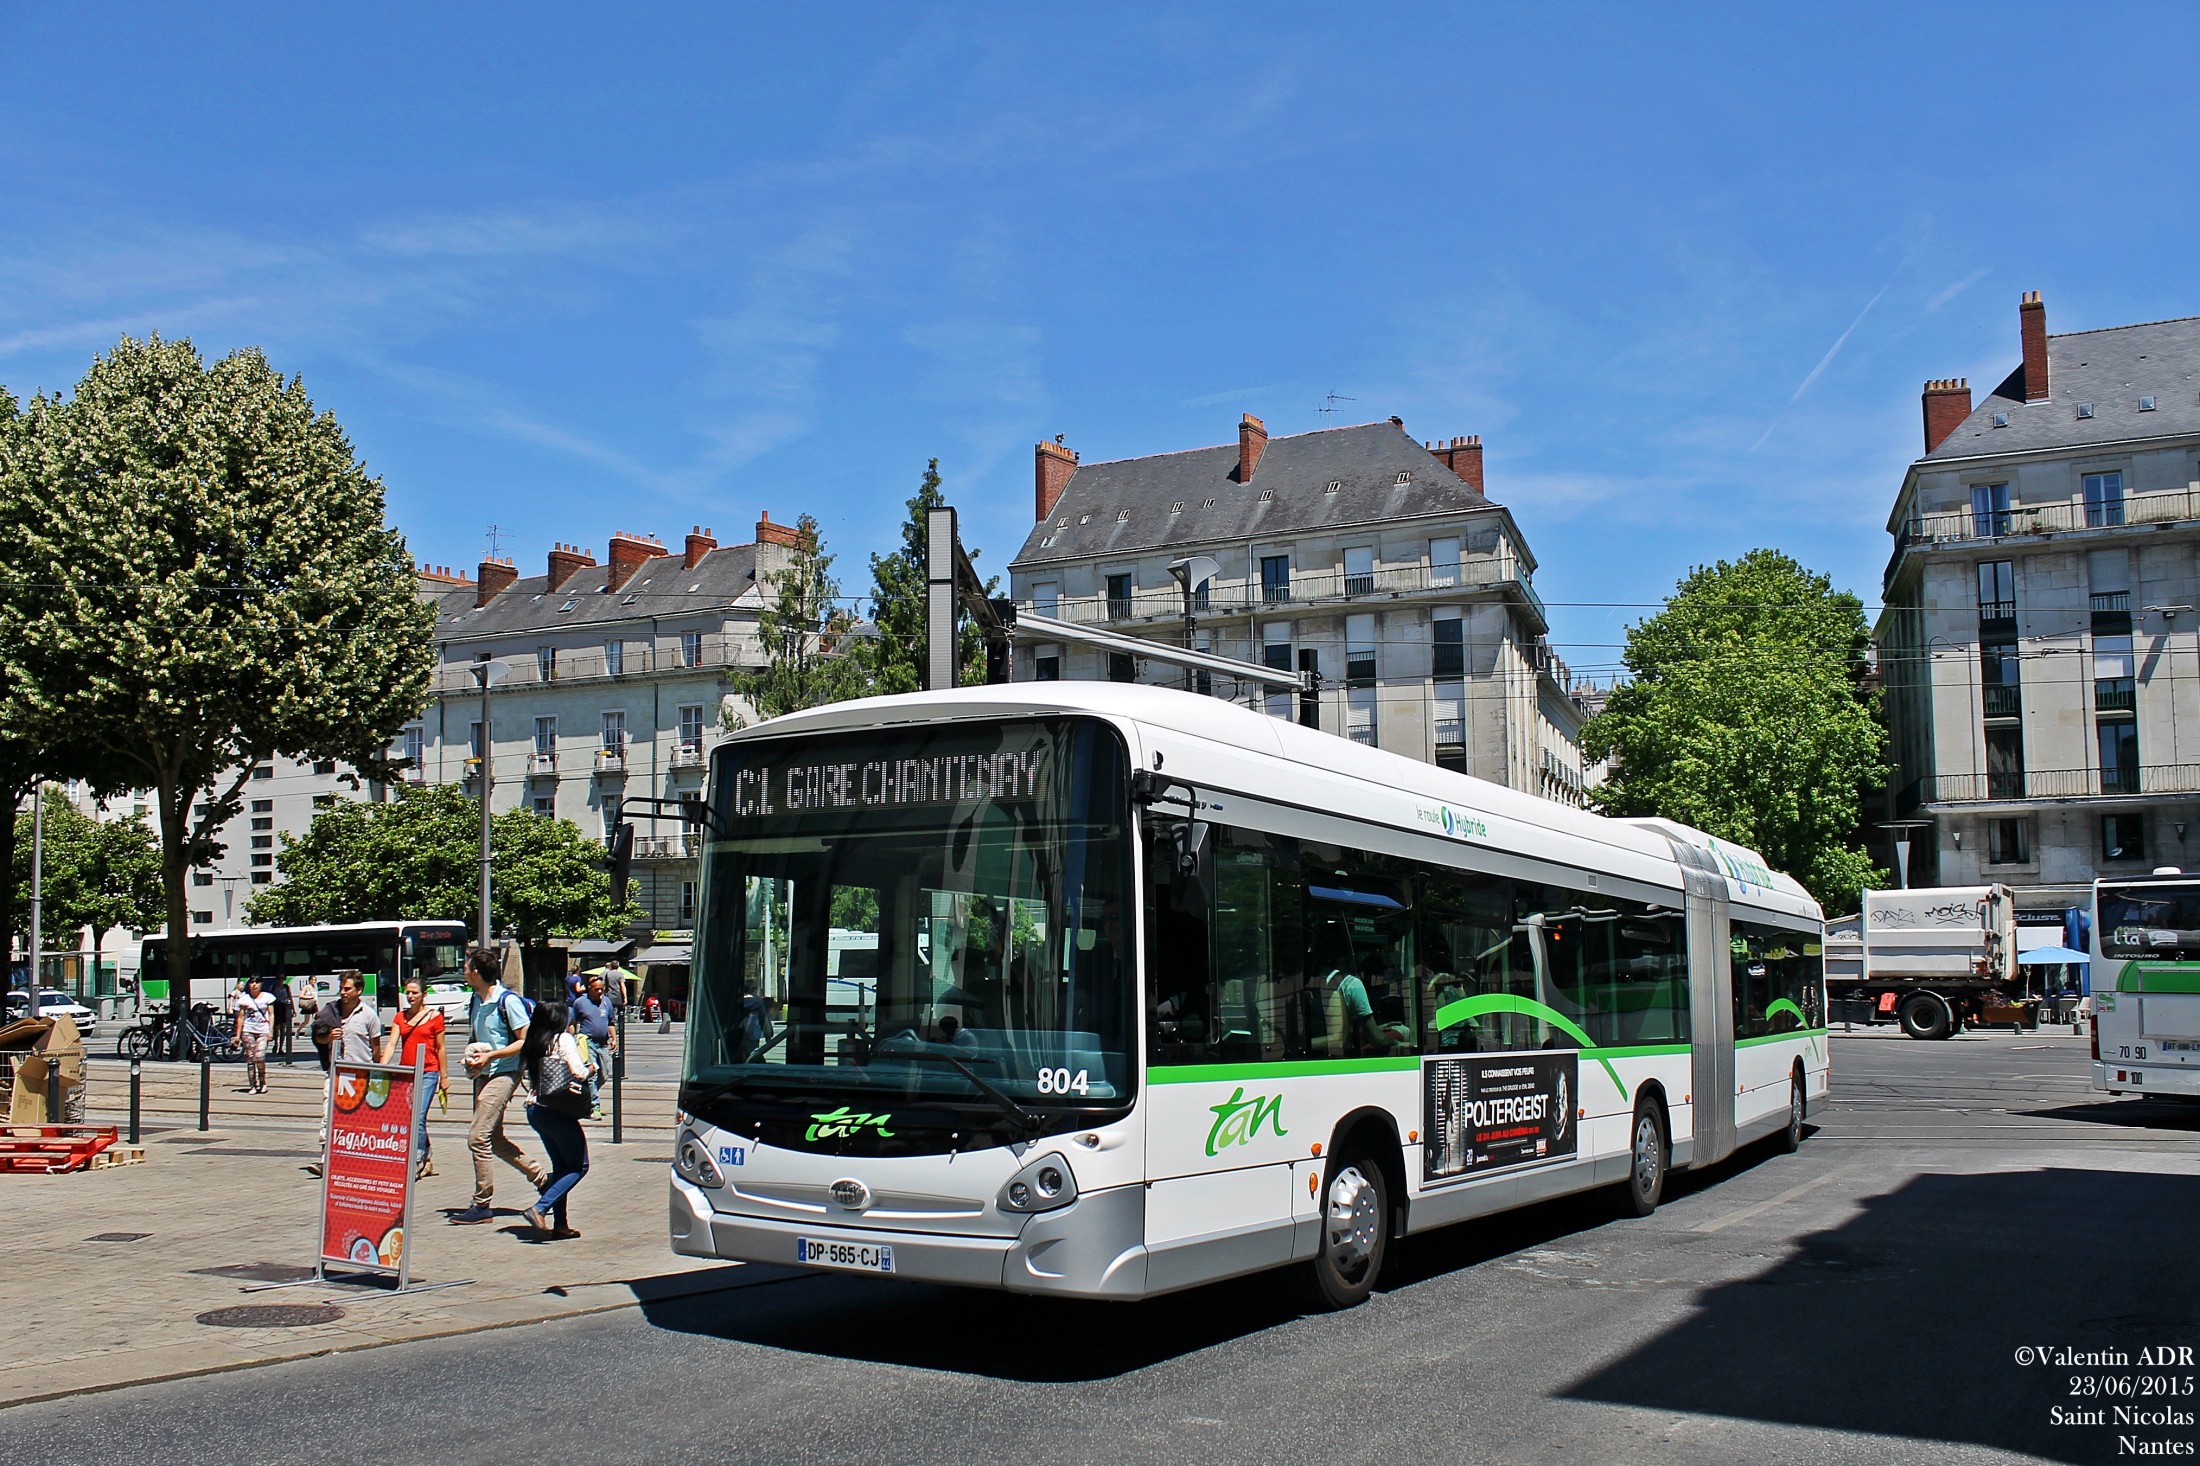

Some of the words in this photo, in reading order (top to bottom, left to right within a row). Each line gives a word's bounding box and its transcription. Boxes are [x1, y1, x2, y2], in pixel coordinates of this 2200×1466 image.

[735, 767, 774, 816] C1
[786, 763, 857, 810] GARE
[861, 751, 1041, 805] CHANTENAY
[1424, 809, 1441, 824] roule
[1454, 812, 1487, 838] Hybride
[2119, 1045, 2130, 1058] 70
[2135, 1046, 2147, 1060] 90
[1037, 1067, 1089, 1096] 804
[2130, 1072, 2143, 1085] 100
[805, 1106, 895, 1142] tan
[1205, 1086, 1288, 1157] tan
[1464, 1094, 1549, 1129] POLTERGEIST
[808, 1242, 879, 1267] DP-565-CJ
